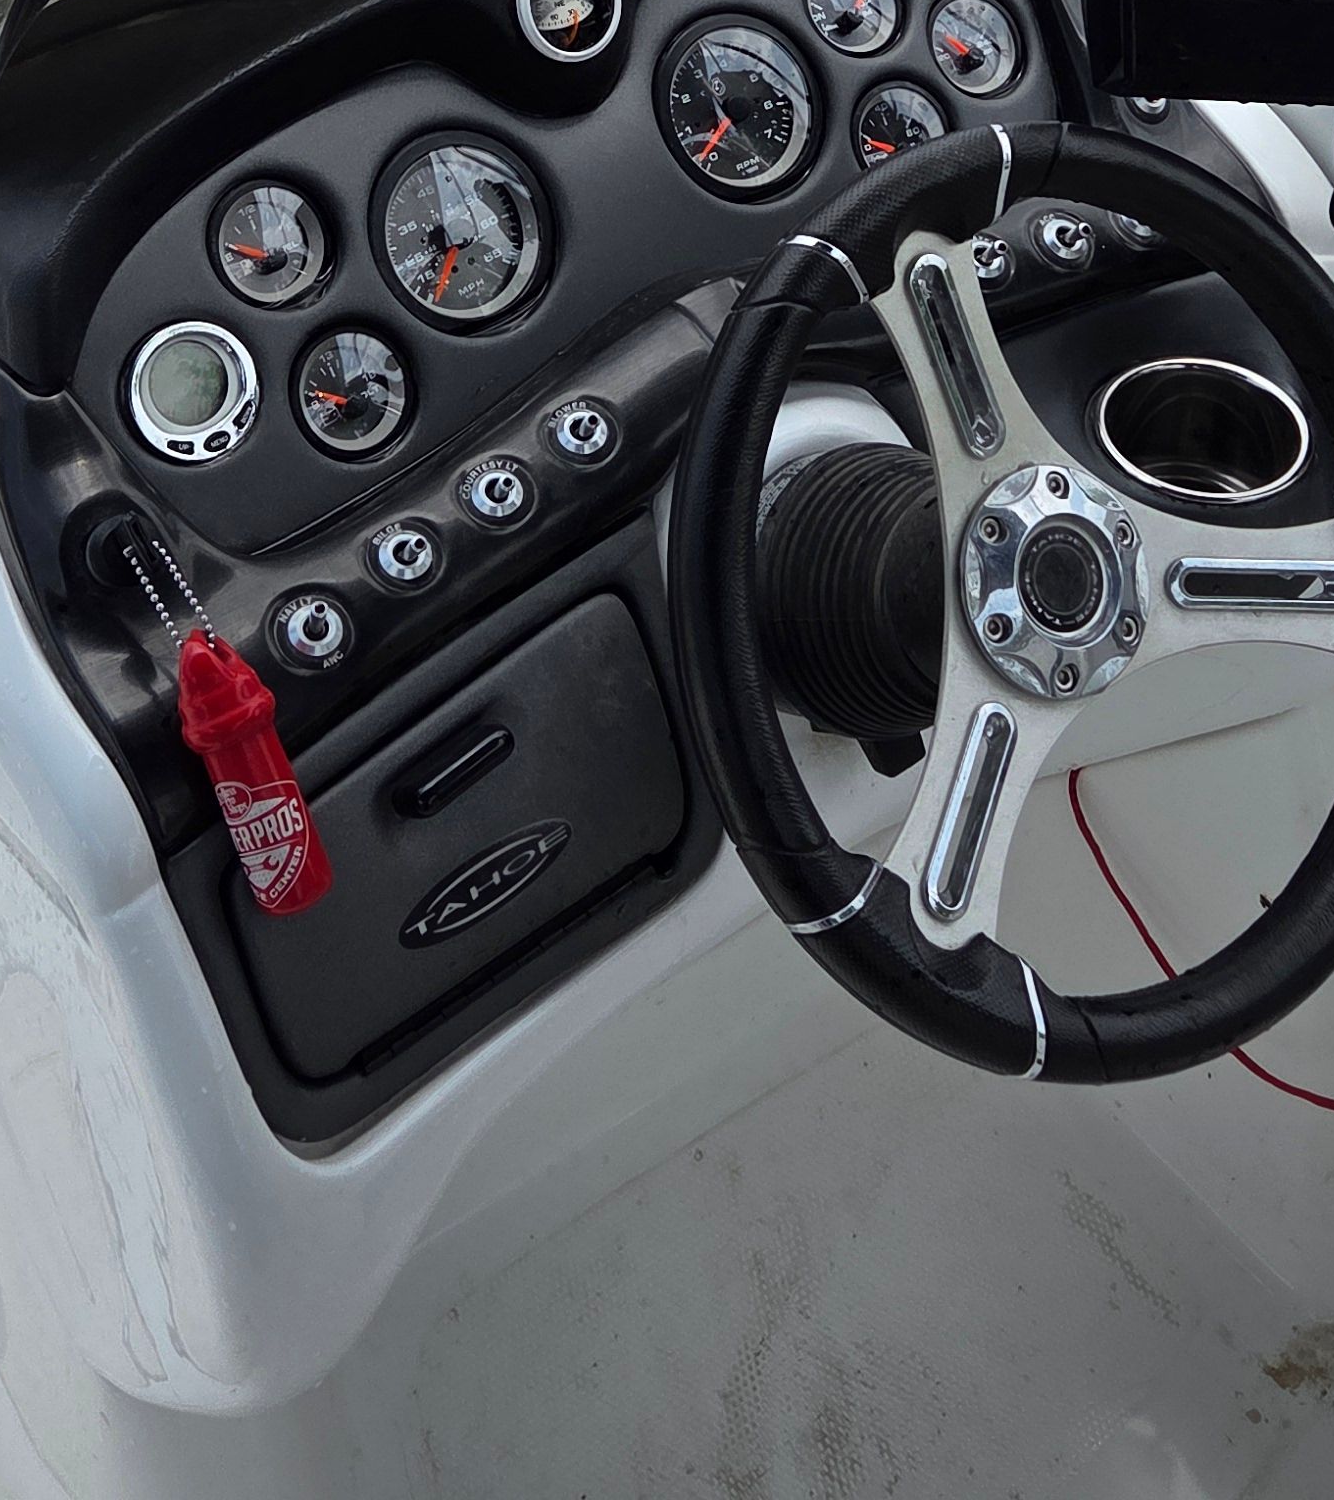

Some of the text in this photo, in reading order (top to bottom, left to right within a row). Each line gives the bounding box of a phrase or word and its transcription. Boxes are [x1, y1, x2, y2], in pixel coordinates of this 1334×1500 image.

[708, 152, 719, 162] 0
[736, 156, 761, 171] RPM
[397, 221, 417, 236] 35
[458, 278, 485, 296] MPH
[548, 401, 587, 428] BLOWER
[462, 460, 503, 499] COURTESY
[372, 523, 402, 546] BILGE
[278, 602, 298, 624] NAV
[323, 650, 344, 669] ANC
[268, 846, 303, 899] CENTER
[405, 825, 567, 935] TAHOE
